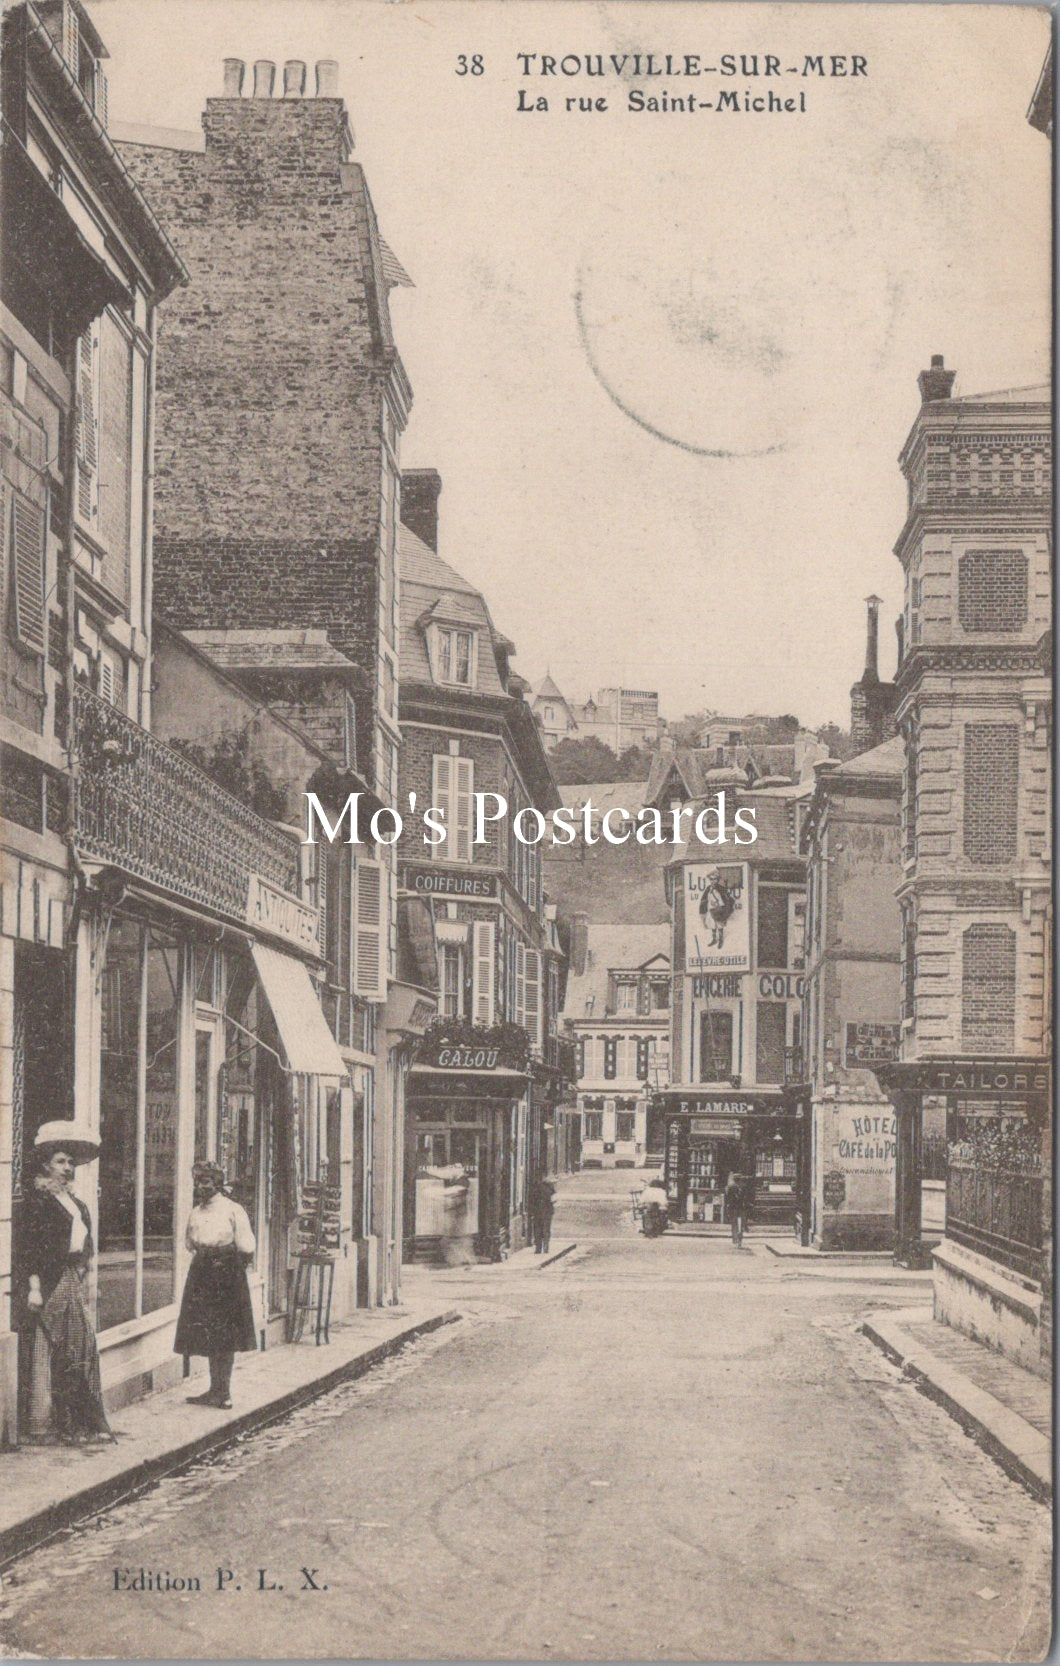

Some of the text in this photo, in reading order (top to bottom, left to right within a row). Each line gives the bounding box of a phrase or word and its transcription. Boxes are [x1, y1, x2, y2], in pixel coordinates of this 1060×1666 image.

[415, 874, 490, 895] COIFFURES
[937, 1072, 1048, 1089] TAILORS
[696, 1102, 748, 1114] LAMARE
[864, 1142, 875, 1159] de
[875, 1142, 884, 1159] la
